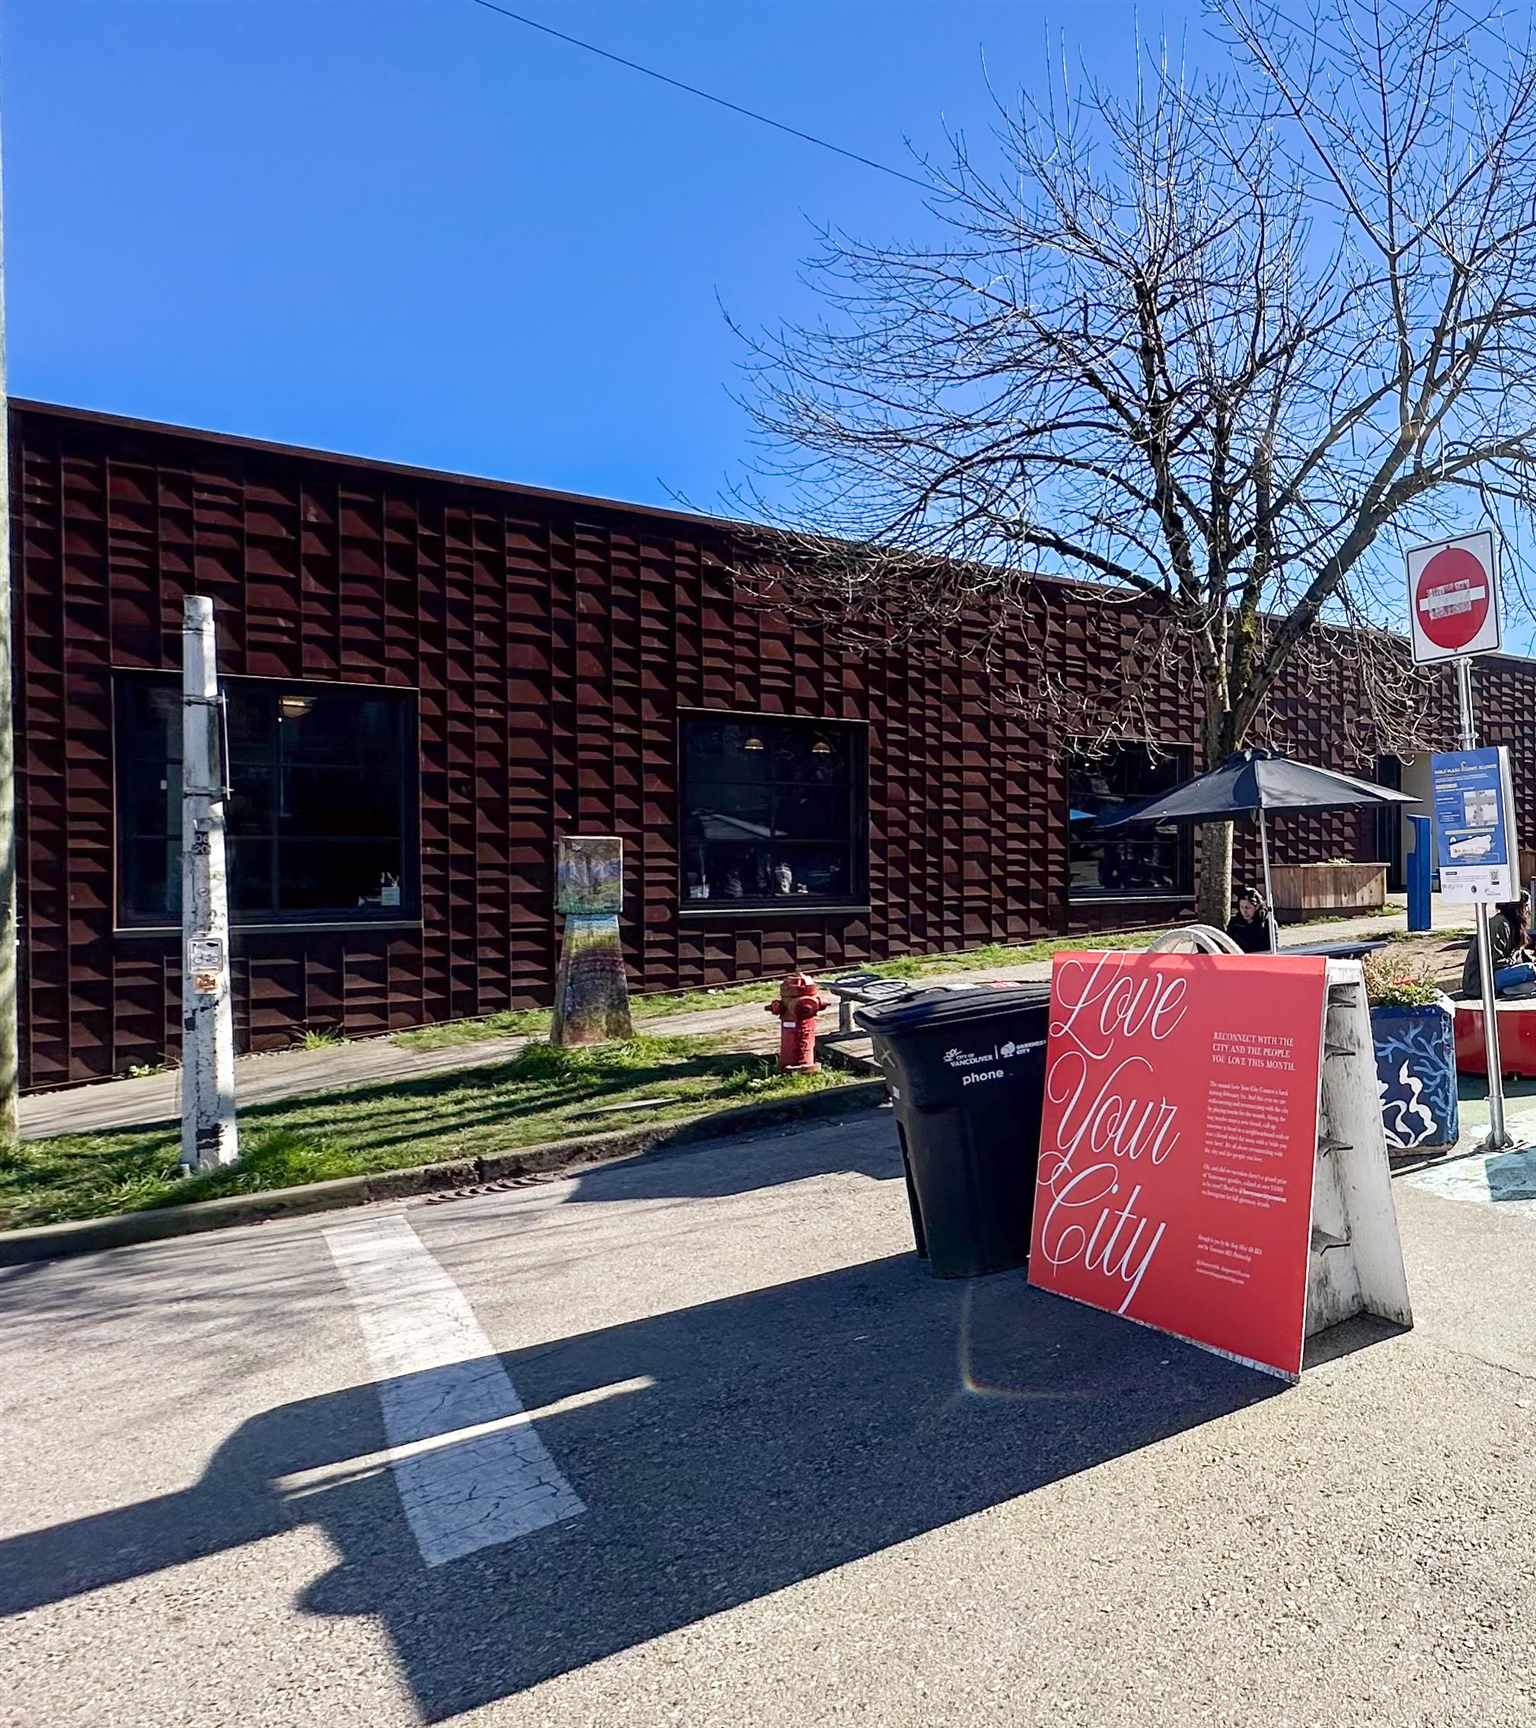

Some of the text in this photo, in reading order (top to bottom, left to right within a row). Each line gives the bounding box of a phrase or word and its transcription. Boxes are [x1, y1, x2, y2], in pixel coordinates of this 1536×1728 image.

[1049, 951, 1188, 1060] Love
[1213, 1032, 1294, 1047] RECONNECT WITH THE
[1212, 1043, 1291, 1059] CITY AND THE PEOPLE
[950, 1054, 993, 1067] VANCOUVER
[1211, 1054, 1226, 1063] YOU
[1227, 1056, 1247, 1066] LOVE
[1247, 1058, 1265, 1067] THIS
[962, 1069, 1004, 1086] phone
[1037, 1051, 1181, 1186] Your
[1041, 1163, 1168, 1314] City
